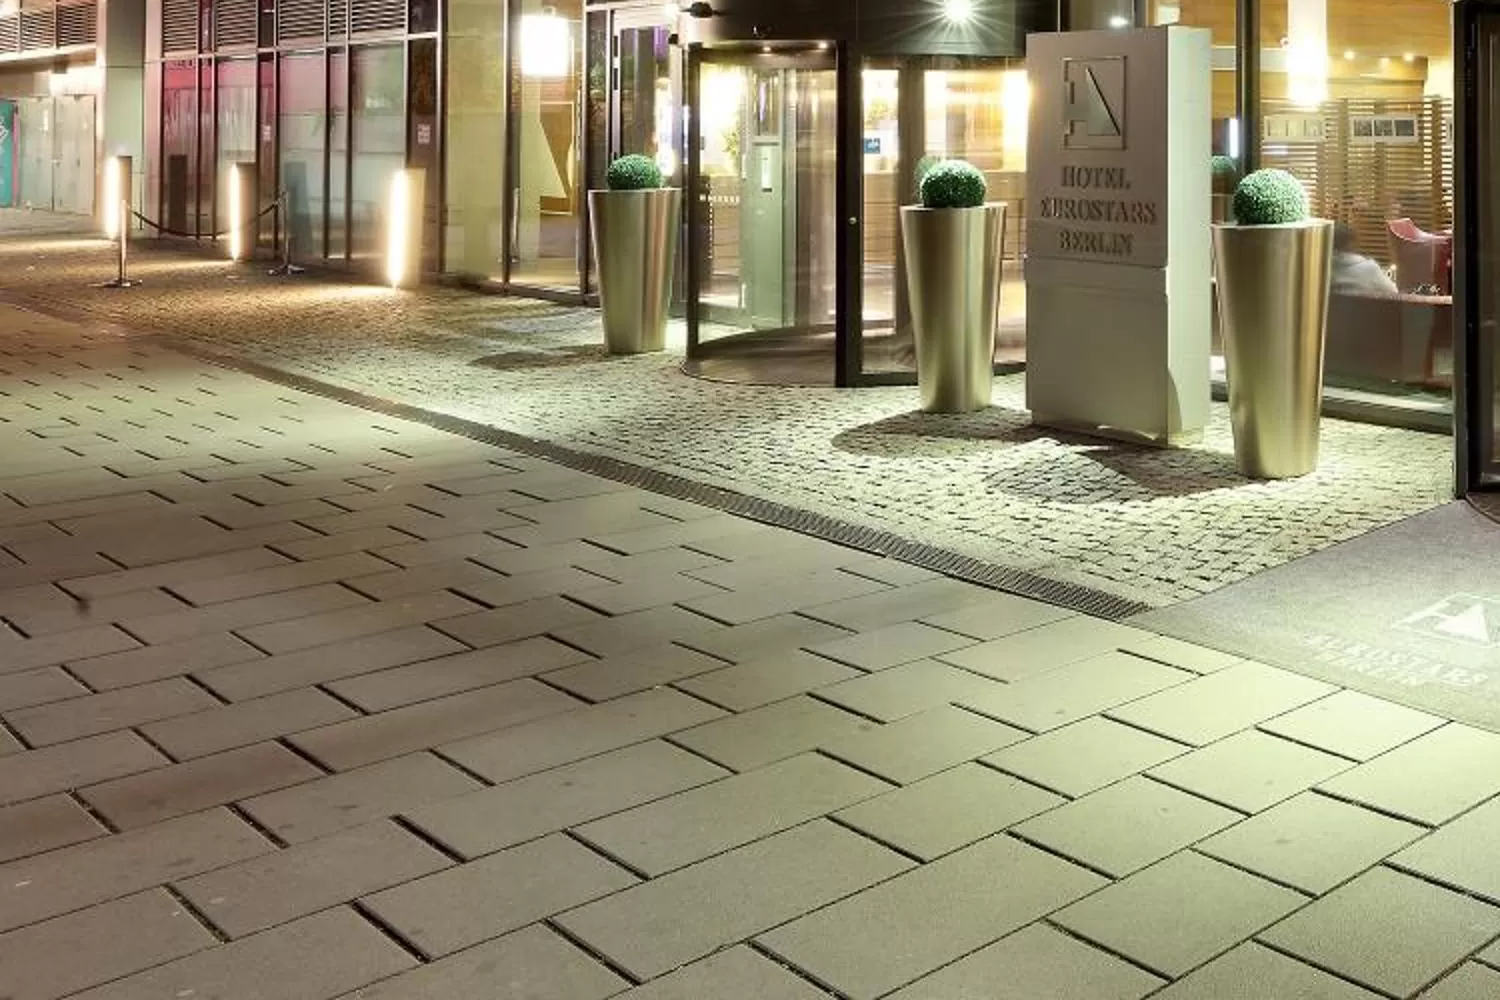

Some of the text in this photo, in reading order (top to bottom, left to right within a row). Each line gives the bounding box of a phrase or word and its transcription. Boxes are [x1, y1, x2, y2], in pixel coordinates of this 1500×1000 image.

[1061, 165, 1132, 190] HOTEL
[1040, 196, 1157, 225] EUROSTARS
[1059, 230, 1134, 256] BERLIN
